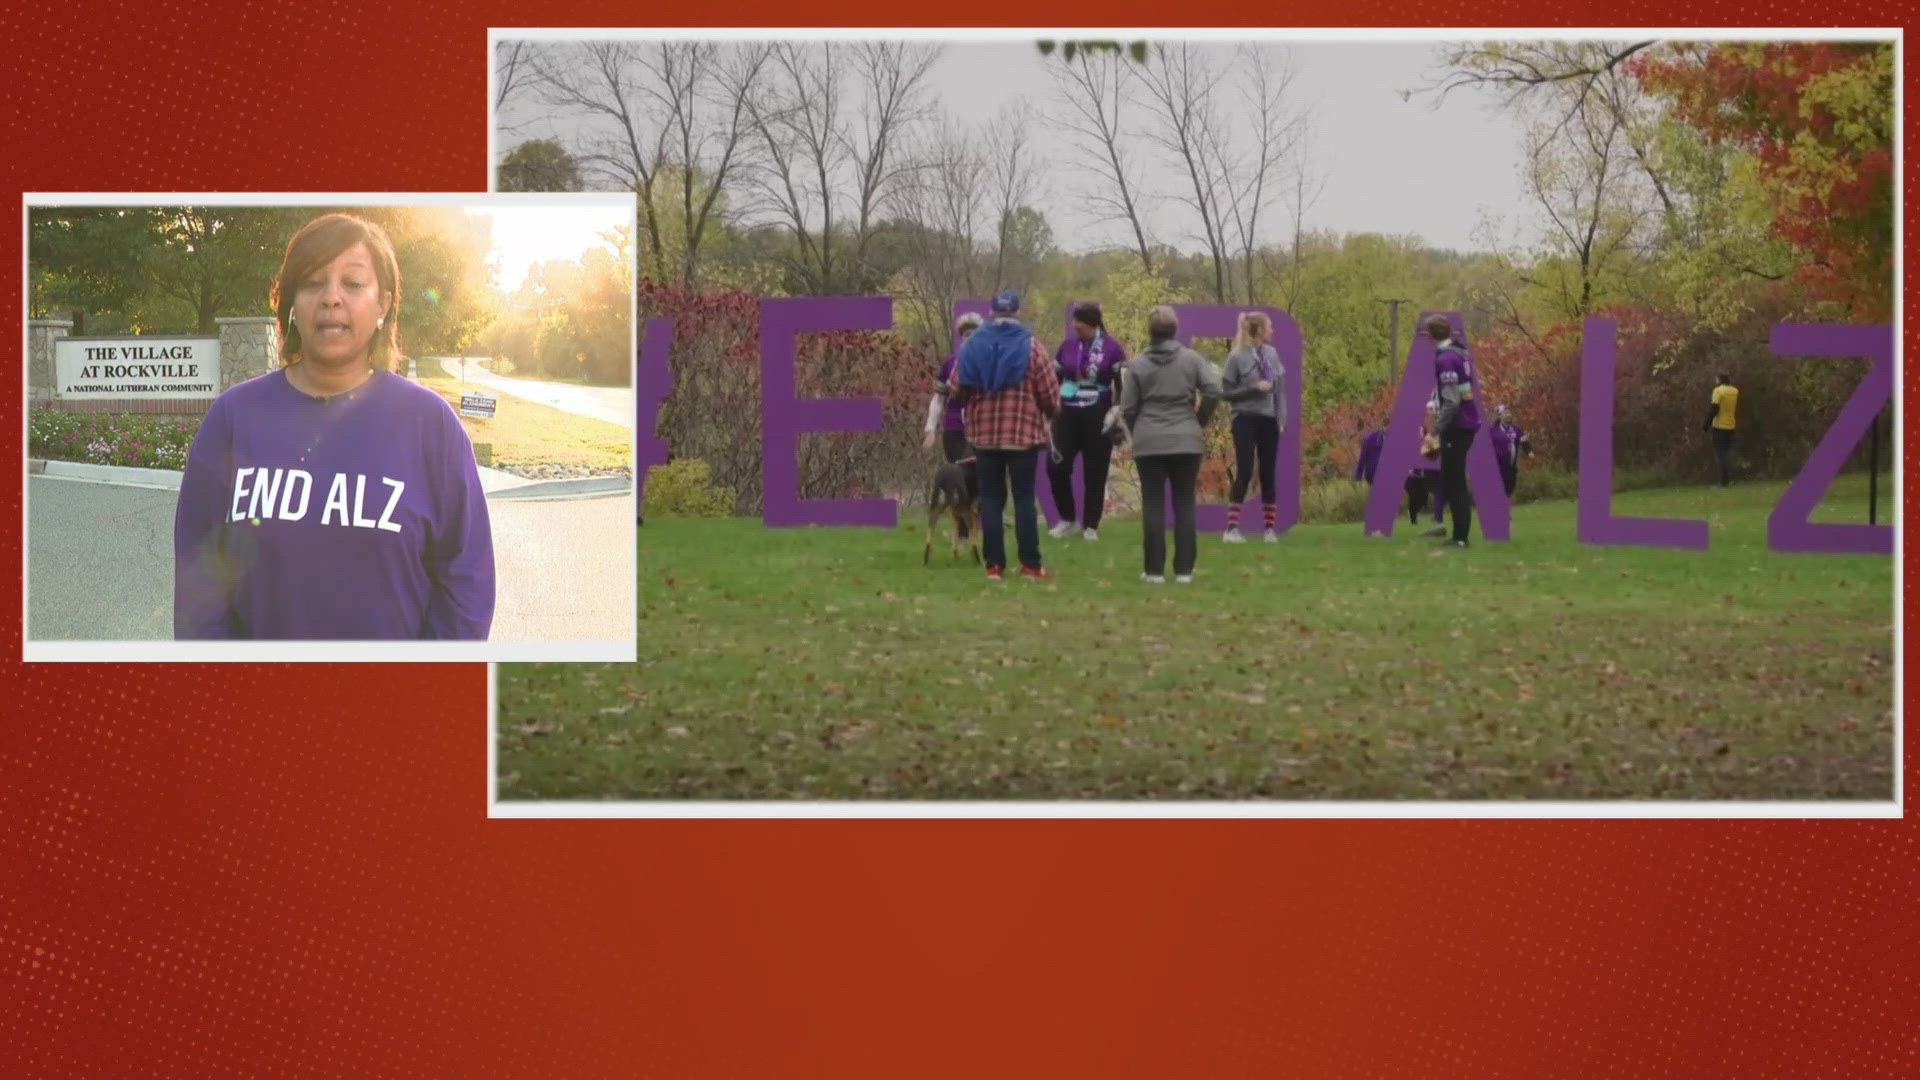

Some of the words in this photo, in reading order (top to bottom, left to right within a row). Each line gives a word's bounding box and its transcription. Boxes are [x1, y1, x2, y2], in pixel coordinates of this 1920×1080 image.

[85, 347, 117, 360] THE
[121, 346, 193, 360] VILLAGE
[80, 365, 100, 378] AT
[104, 364, 199, 378] ROCKVILLE
[66, 385, 72, 393] A
[74, 384, 114, 393] NATIONAL
[116, 384, 160, 392] LUTHERAN
[161, 384, 214, 392] COMMUNITY
[321, 472, 405, 533] ALZ
